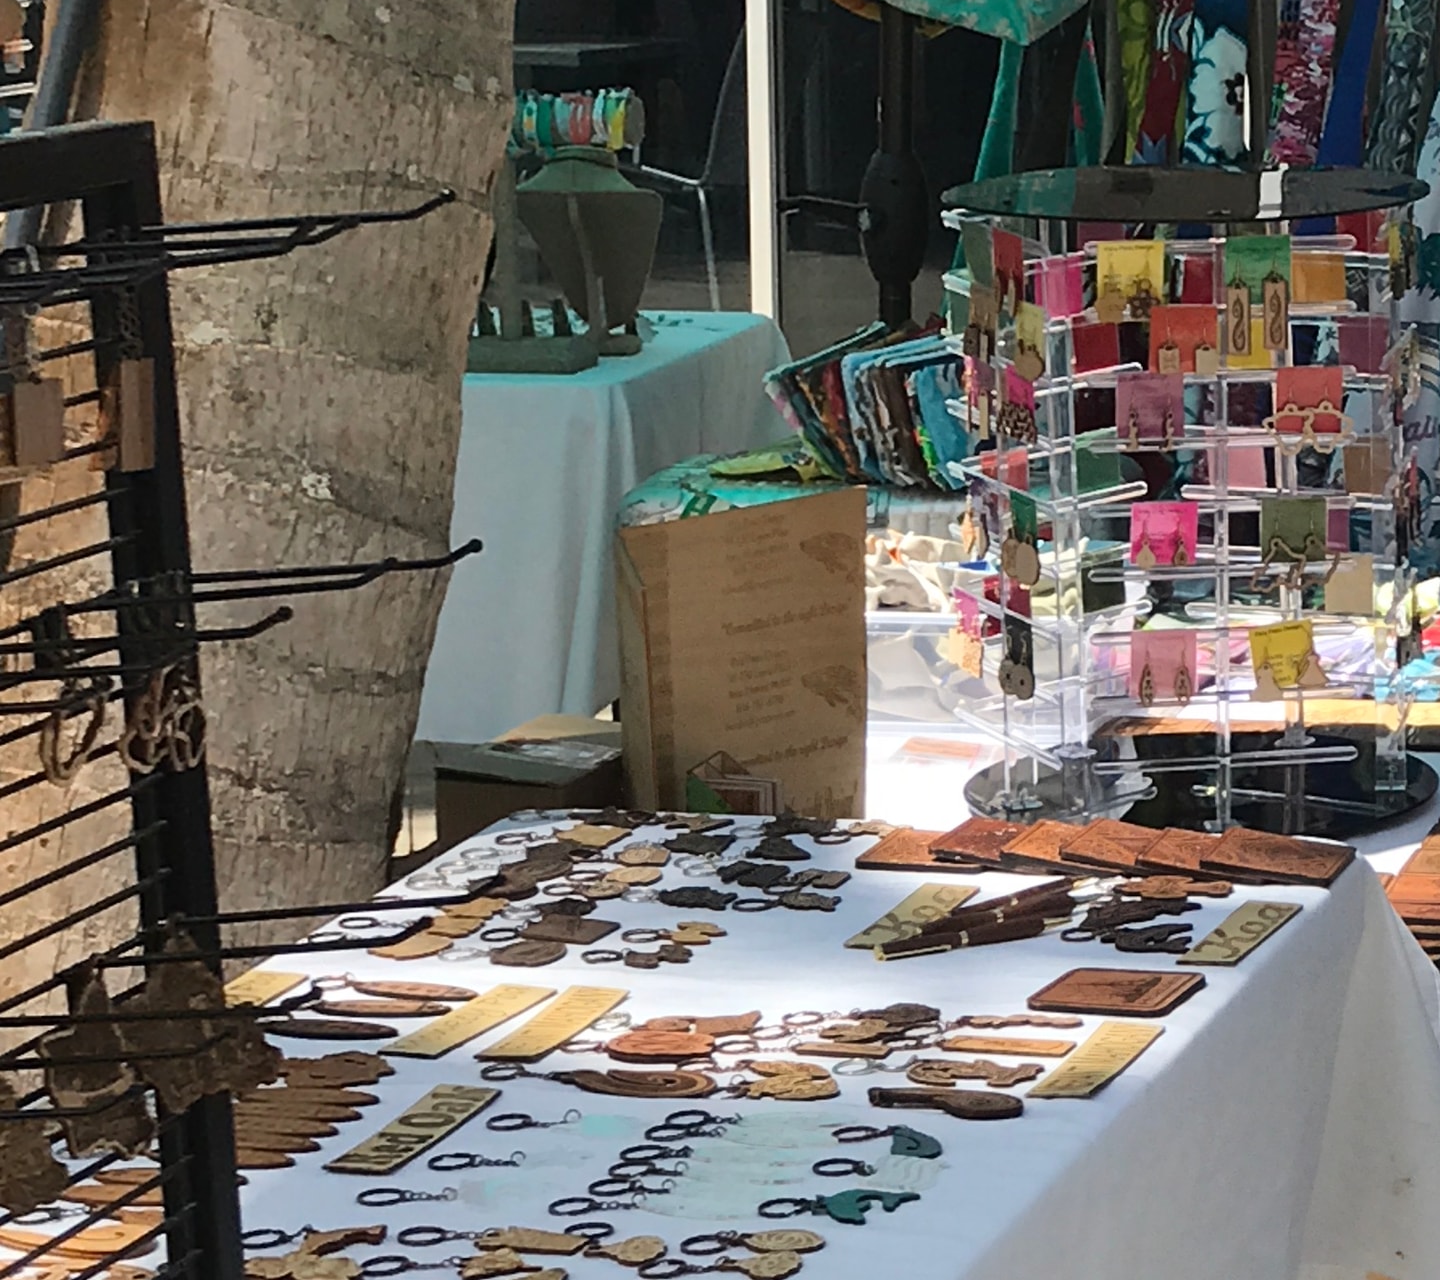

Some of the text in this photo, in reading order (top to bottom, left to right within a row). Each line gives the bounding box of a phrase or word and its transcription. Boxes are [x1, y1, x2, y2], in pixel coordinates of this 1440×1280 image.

[1193, 903, 1294, 959] Koa
[334, 1085, 494, 1165] Red Oak
